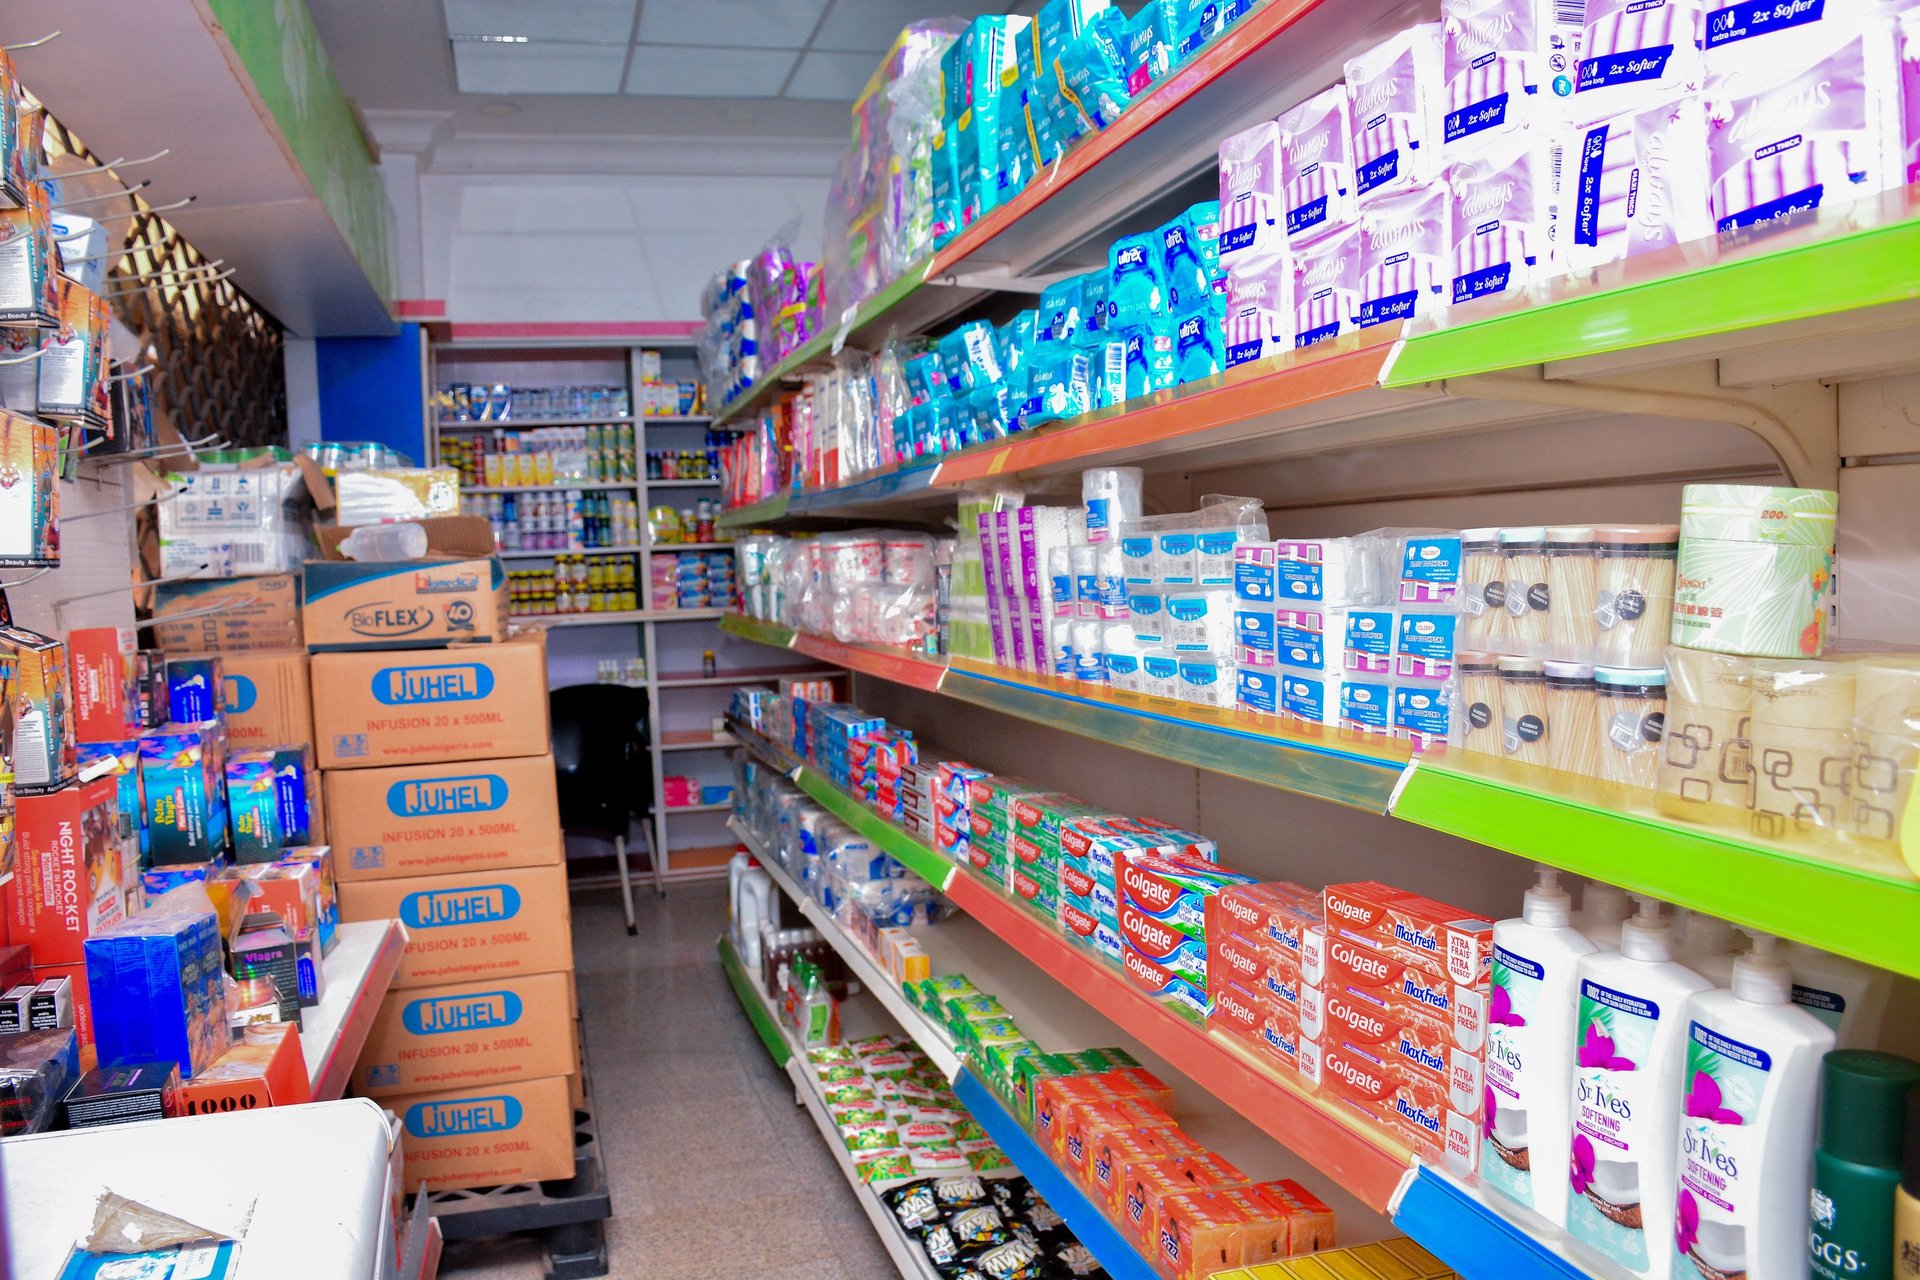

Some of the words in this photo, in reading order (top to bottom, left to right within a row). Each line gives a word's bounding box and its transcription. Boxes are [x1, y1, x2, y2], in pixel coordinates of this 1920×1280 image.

[1627, 2, 1644, 13] MAXI
[1645, 0, 1665, 9] THICK
[1752, 9, 1770, 24] 2x
[1773, 0, 1815, 19] Softer
[1456, 11, 1514, 55] always
[1712, 31, 1729, 43] extra
[1729, 27, 1746, 38] long
[1609, 64, 1625, 76] 2x
[1626, 57, 1662, 75] Softer
[1580, 80, 1593, 88] extra
[1593, 77, 1605, 87] long
[1354, 77, 1398, 117] always
[1468, 115, 1477, 125] 2x
[1478, 105, 1501, 123] Softer
[1755, 145, 1775, 159] MAXI
[1775, 135, 1802, 152] THICK
[1369, 169, 1377, 180] 2x
[1378, 159, 1395, 177] Softer
[1584, 177, 1594, 194] 2x
[1631, 170, 1639, 191] MAXI
[1462, 181, 1515, 219] always
[1627, 191, 1636, 216] THICK
[1580, 196, 1593, 237] Softer
[1371, 218, 1426, 251] always
[1474, 281, 1484, 290] 2x
[1484, 273, 1505, 289] Softer
[1381, 306, 1390, 316] 2x
[1390, 299, 1412, 314] Softer
[1760, 509, 1784, 520] 200
[76, 654, 88, 692] ROCKET
[79, 693, 89, 721] NIGHT
[367, 717, 430, 732] INFUSION
[434, 716, 449, 727] 20
[464, 712, 504, 724] 500ML
[382, 740, 493, 756] www.juhelnigeria.com
[1015, 802, 1038, 821] Colgate
[382, 830, 445, 844] INFUSION
[449, 826, 464, 838] 20
[479, 822, 519, 836] 500ML
[1061, 831, 1087, 851] Colgate
[59, 821, 75, 866] NIGHT
[51, 840, 60, 873] ROCKET
[398, 850, 508, 867] www.juhelnigeria.com
[1064, 867, 1089, 891] Colgate
[1124, 867, 1171, 904] Colgate
[54, 883, 63, 915] POCKET
[62, 869, 80, 932] ROCKET
[1179, 899, 1193, 913] Triple
[1220, 893, 1260, 925] Colgate
[1327, 895, 1372, 923] Colgate
[1065, 905, 1092, 930] Colgate
[1177, 910, 1193, 924] Action
[462, 935, 477, 948] 20
[491, 932, 531, 944] 500ML
[1123, 910, 1172, 950] Colgate
[1181, 946, 1195, 960] Triple
[1304, 944, 1319, 958] XTRA
[1450, 936, 1470, 950] XTRA
[1451, 947, 1471, 959] FRAIS
[246, 948, 282, 963] Viagra
[1178, 956, 1194, 971] Action
[1219, 942, 1257, 976] Colgate
[1304, 953, 1320, 968] FRESH
[1331, 943, 1389, 979] Colgate
[1450, 956, 1470, 971] XTRA
[411, 960, 520, 977] www.juhelnigeria.com
[1125, 952, 1163, 986] Colgate
[1450, 966, 1472, 979] FRESCO
[1302, 999, 1317, 1013] XTRA
[1586, 984, 1600, 1001] 100%
[1613, 994, 1623, 1003] DAILY
[1623, 997, 1648, 1010] HYDRATION
[1820, 1001, 1836, 1010] GLOW
[1217, 990, 1255, 1025] Colgate
[1302, 1008, 1318, 1024] FRESH
[1327, 998, 1385, 1037] Colgate
[1457, 1002, 1478, 1020] XTRA
[1619, 1002, 1632, 1011] NEEDS
[1638, 1008, 1652, 1017] GLOW
[1457, 1015, 1479, 1032] FRESH
[399, 1045, 460, 1061] INFUSION
[464, 1042, 479, 1054] 20
[493, 1037, 533, 1049] 500ML
[1694, 1026, 1708, 1045] 100%
[1731, 1043, 1758, 1059] HYDRATION
[1301, 1051, 1315, 1066] XTRA
[1301, 1061, 1316, 1076] FRESH
[414, 1064, 522, 1083] www.juhelnigeria.com
[1325, 1053, 1383, 1095] Colgate
[1453, 1065, 1474, 1084] XTRA
[1487, 1058, 1514, 1083] SOFTENING
[1453, 1079, 1475, 1096] FRESH
[1581, 1105, 1621, 1133] SOFTENING
[1584, 1120, 1597, 1131] BODY
[1596, 1124, 1616, 1138] LOTION
[1449, 1127, 1469, 1147] XTRA
[1577, 1123, 1600, 1139] COCONUT
[1604, 1138, 1625, 1149] ORCHID
[465, 1144, 480, 1156] 20
[493, 1141, 533, 1153] 500ML
[1448, 1141, 1471, 1159] FRESH
[1687, 1158, 1727, 1191] SOFTENING
[1683, 1177, 1703, 1194] COCONUT
[1707, 1193, 1730, 1209] ORCHID
[1689, 1174, 1702, 1187] BODY
[1701, 1180, 1721, 1197] LOTION
